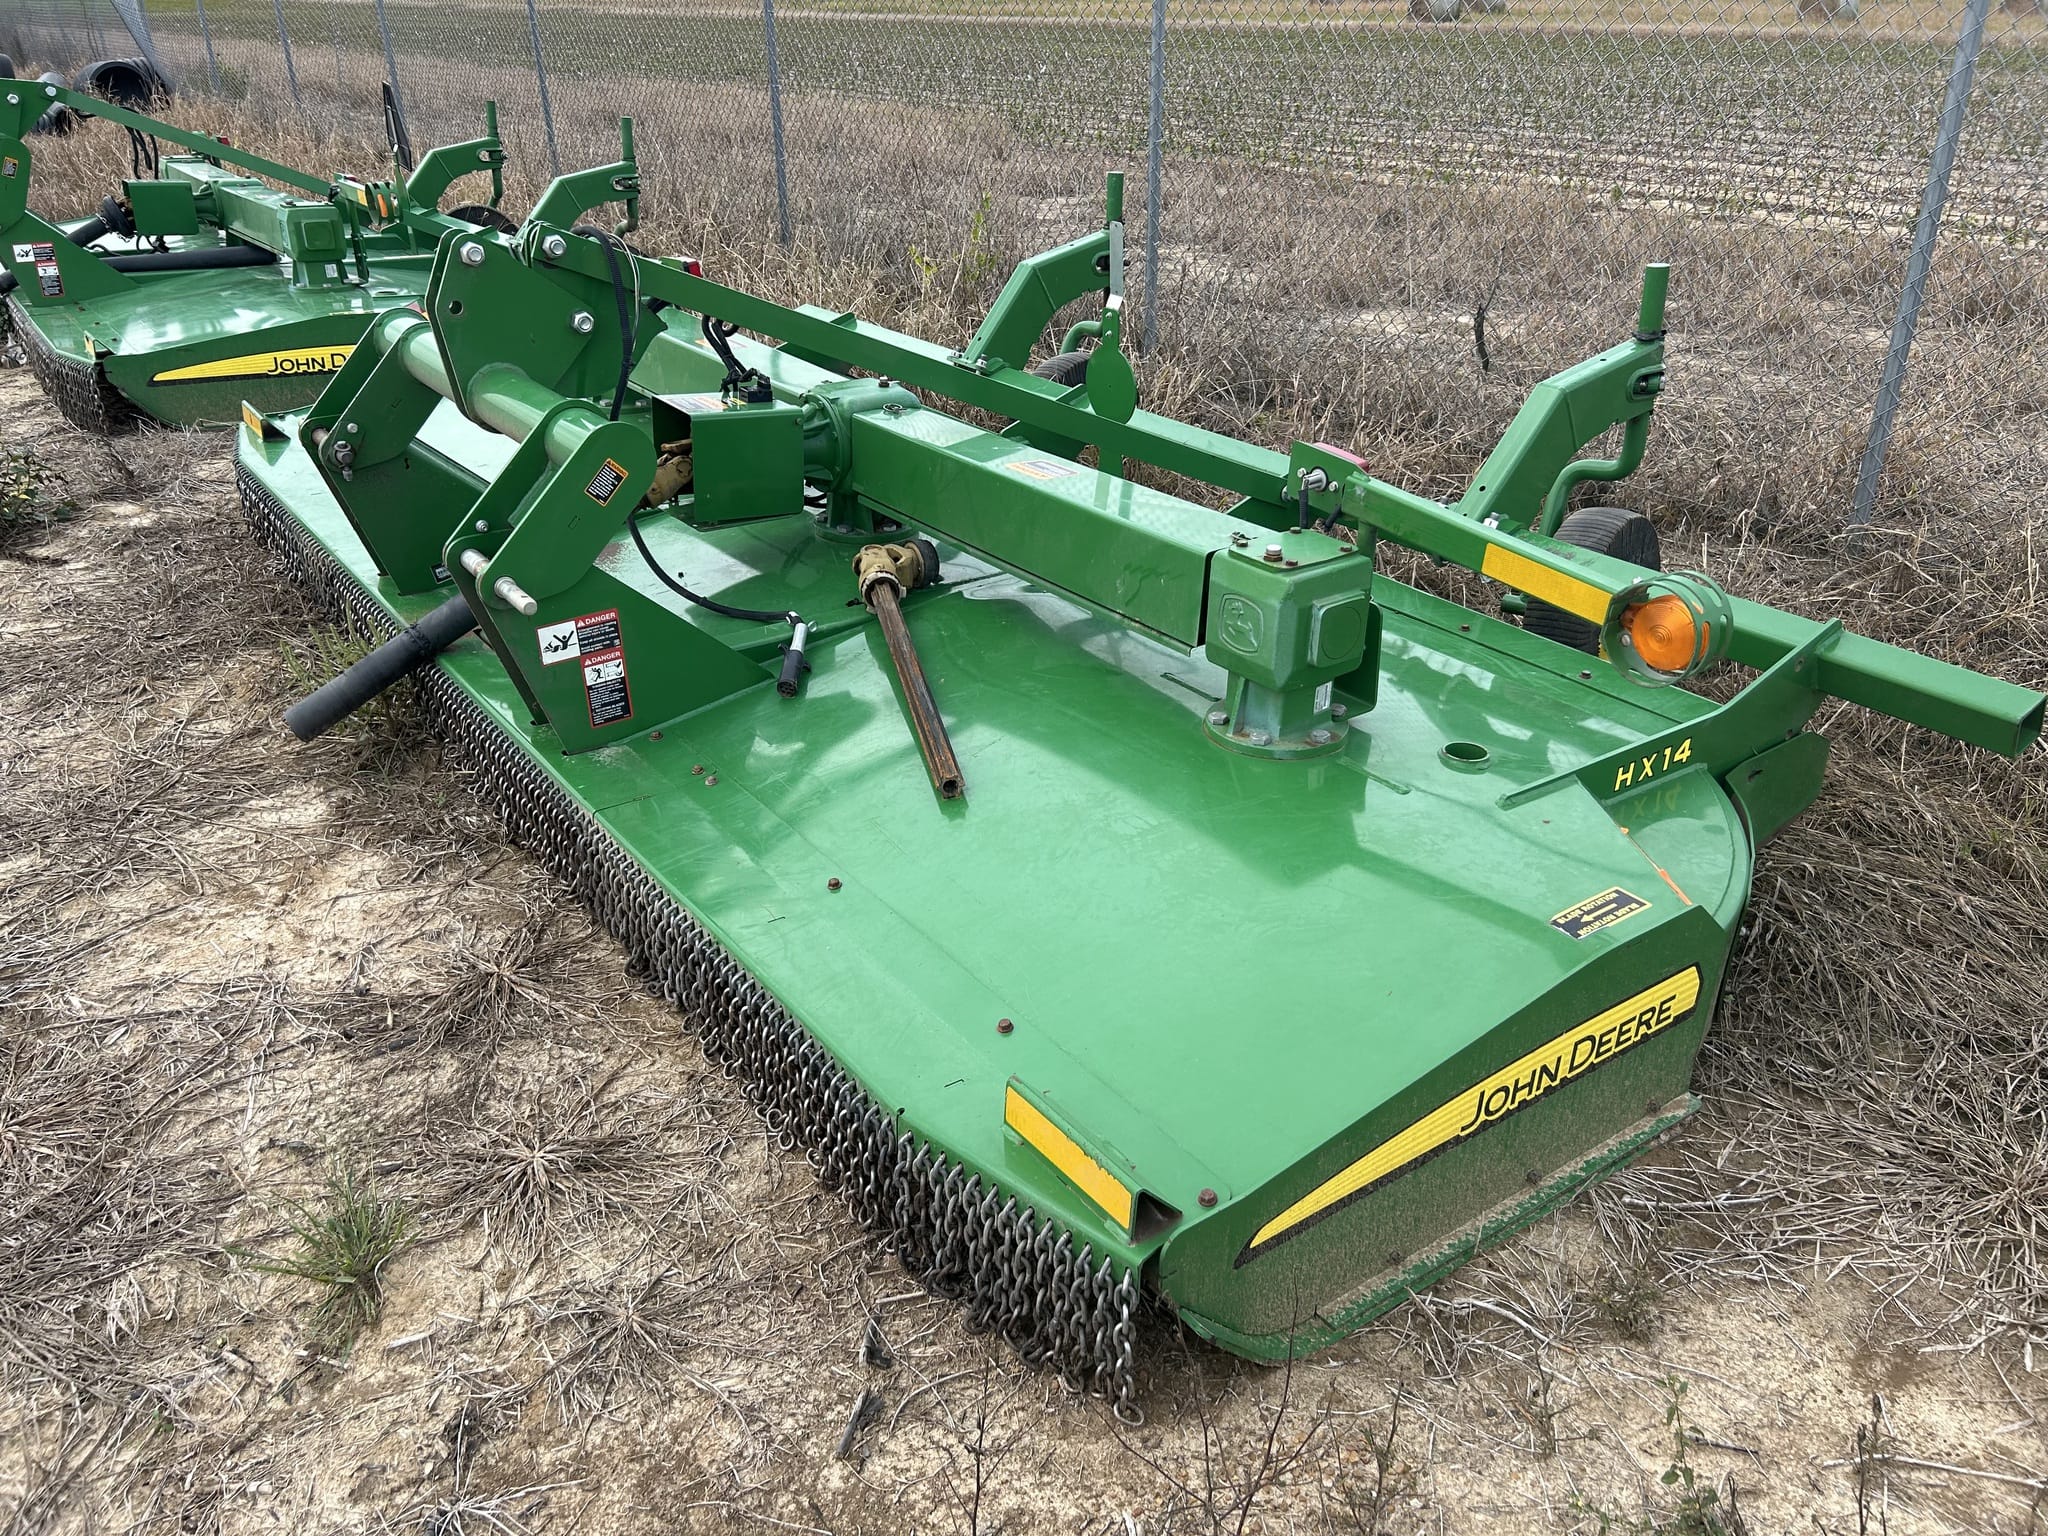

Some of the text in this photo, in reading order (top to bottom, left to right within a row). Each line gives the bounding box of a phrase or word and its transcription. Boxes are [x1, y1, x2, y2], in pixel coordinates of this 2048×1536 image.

[267, 356, 325, 373] JOHN
[585, 612, 616, 625] DANGER
[591, 651, 621, 664] DANGER
[1614, 738, 1692, 792] HX14
[1556, 892, 1619, 924] BLADE ROTATION
[1460, 994, 1677, 1133] JOHN DEERE
